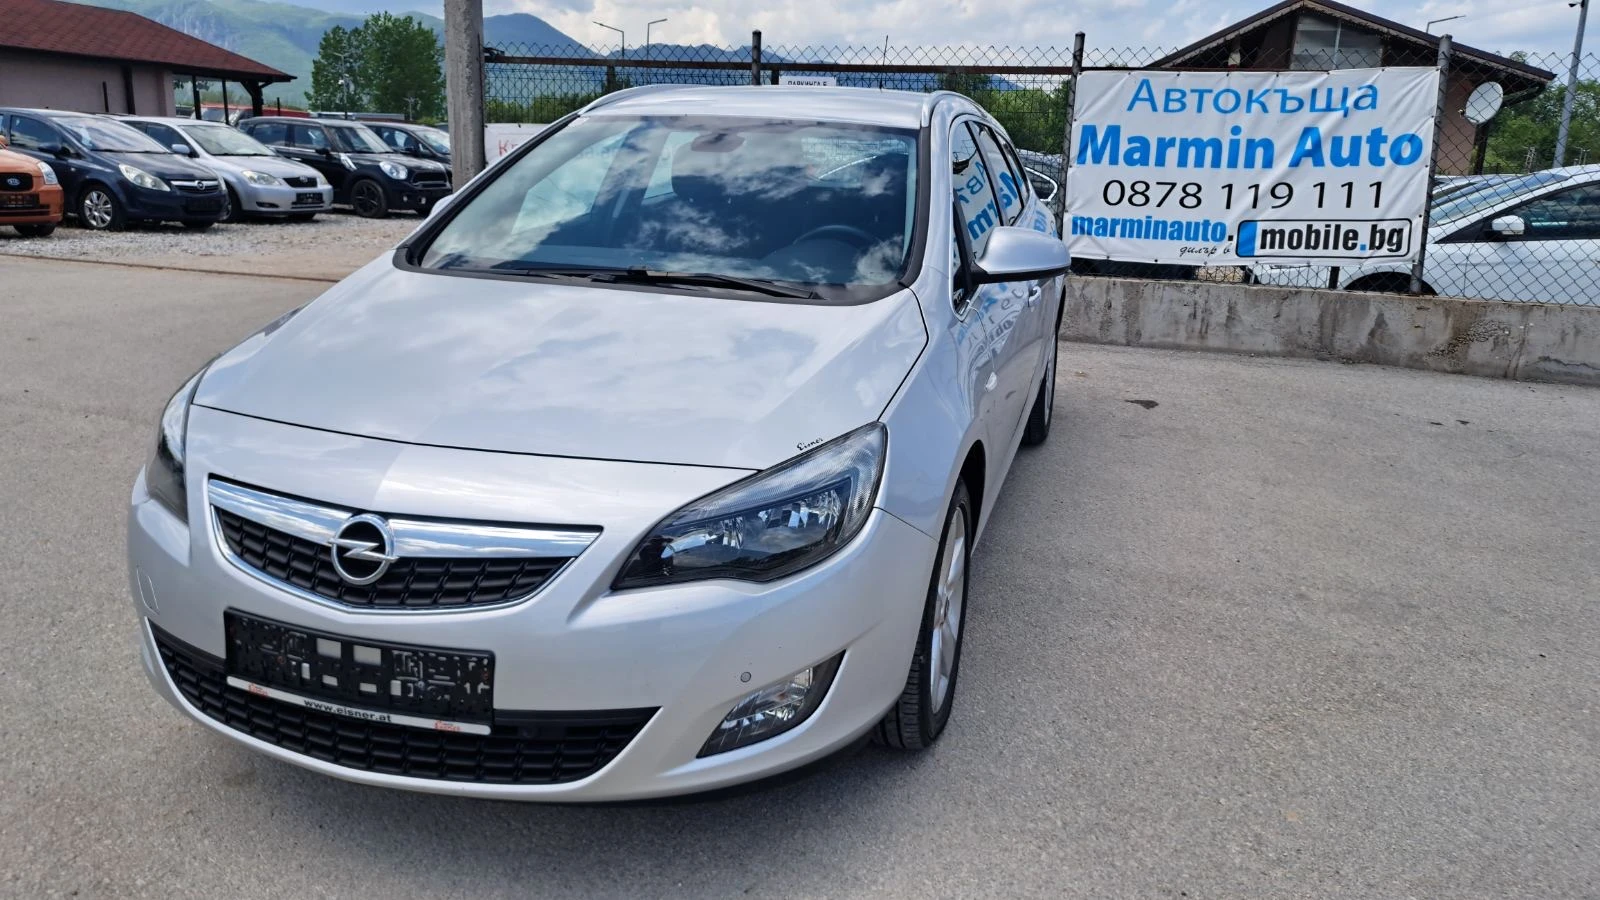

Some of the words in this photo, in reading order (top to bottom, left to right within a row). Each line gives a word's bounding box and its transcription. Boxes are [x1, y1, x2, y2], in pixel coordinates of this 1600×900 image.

[1127, 79, 1378, 118] Автокъща
[1077, 124, 1275, 169] Marmin
[1288, 126, 1424, 168] Auto
[1102, 179, 1203, 208] 0878
[1220, 181, 1295, 210] 119
[1312, 181, 1383, 209] 111
[1259, 223, 1405, 253] mobile.bg
[303, 699, 392, 722] www.eisner.at
